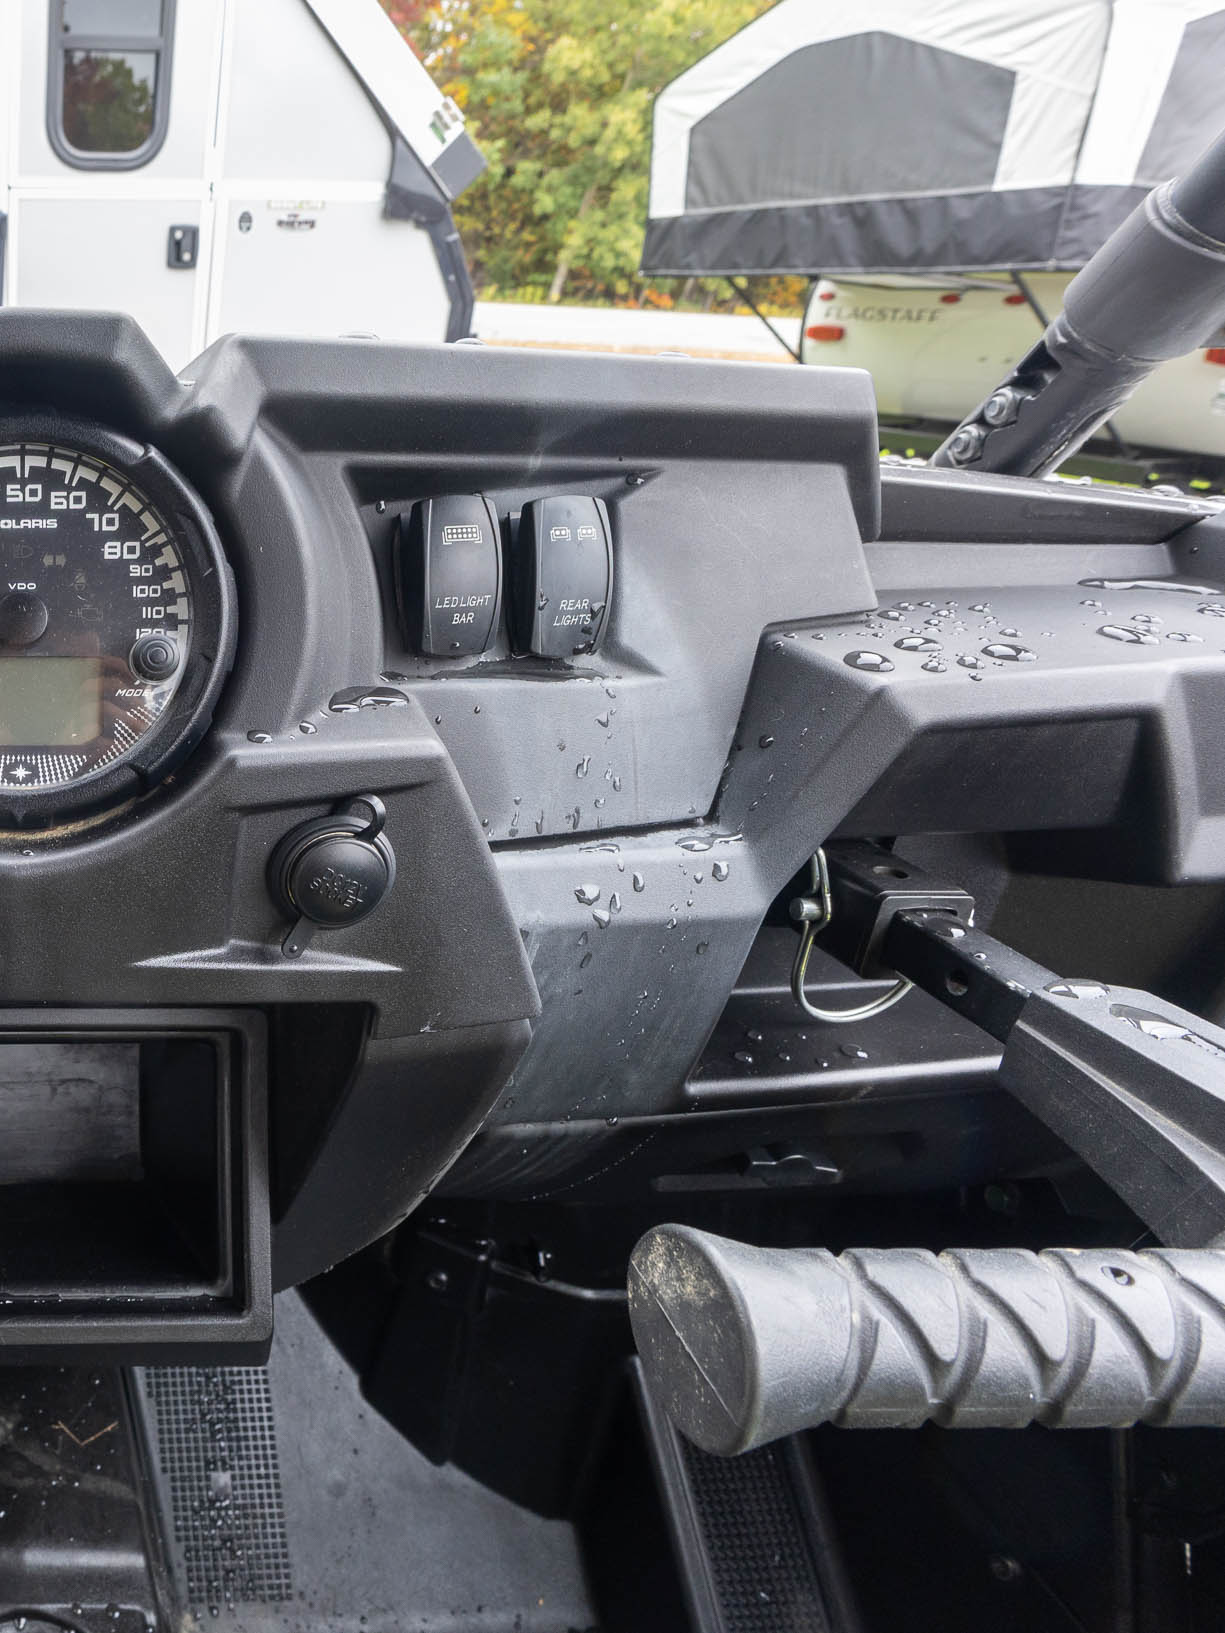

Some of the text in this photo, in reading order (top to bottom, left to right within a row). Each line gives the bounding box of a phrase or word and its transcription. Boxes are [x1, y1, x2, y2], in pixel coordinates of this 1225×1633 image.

[823, 306, 944, 323] FLAGSTAFF
[6, 484, 42, 502] 50
[50, 491, 86, 510] 60
[86, 514, 120, 532] 70
[103, 541, 140, 560] 80
[129, 565, 153, 577] 90
[8, 582, 36, 590] VDO
[132, 586, 161, 598] 100
[435, 595, 491, 609] LED LIGHT
[559, 599, 589, 611] REAR
[142, 606, 165, 619] 110
[452, 613, 475, 625] BAR
[553, 614, 591, 626] LIGHTS
